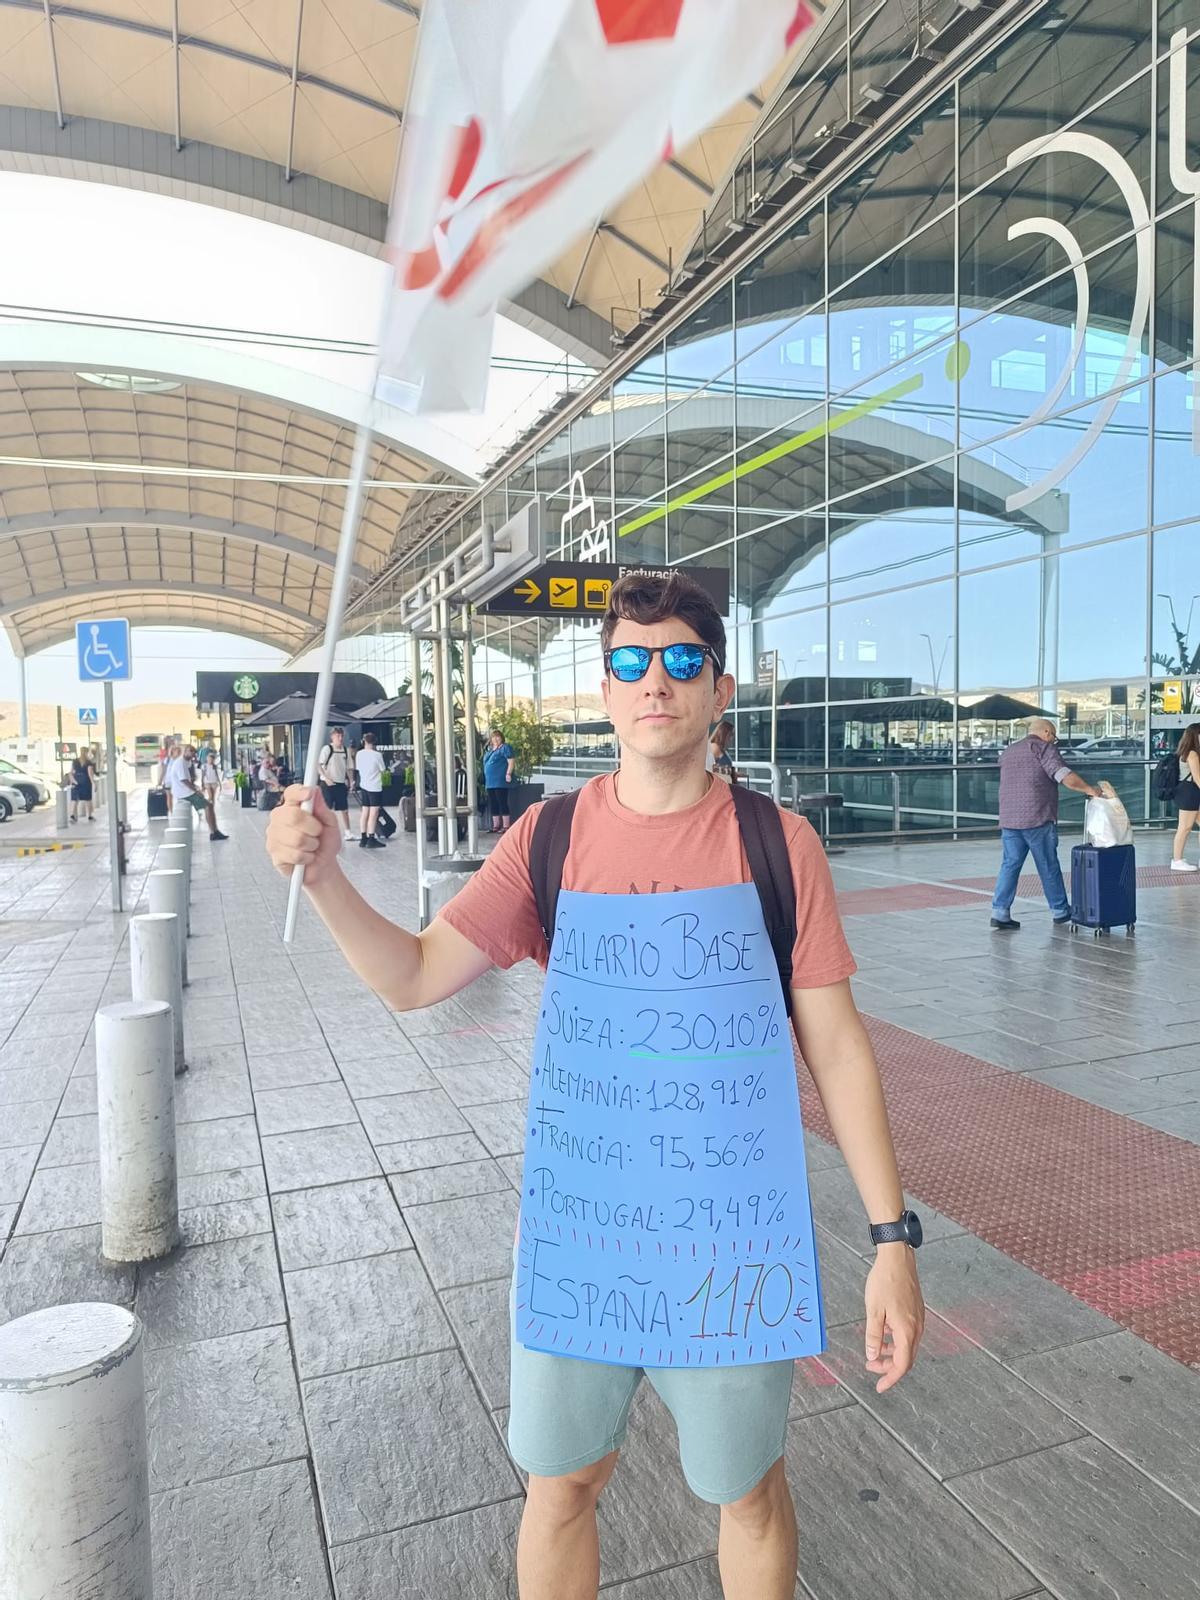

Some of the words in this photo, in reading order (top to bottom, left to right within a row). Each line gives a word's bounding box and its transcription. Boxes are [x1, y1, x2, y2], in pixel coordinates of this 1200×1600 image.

[661, 912, 759, 980] BASE
[630, 1002, 779, 1054] 230,10%
[646, 1071, 767, 1113] 128,91%
[649, 1128, 765, 1172] 95,56%
[533, 1167, 664, 1232] PORTUGAL:
[672, 1188, 788, 1233] 29,49%
[530, 1238, 684, 1337] ESPAÑA:
